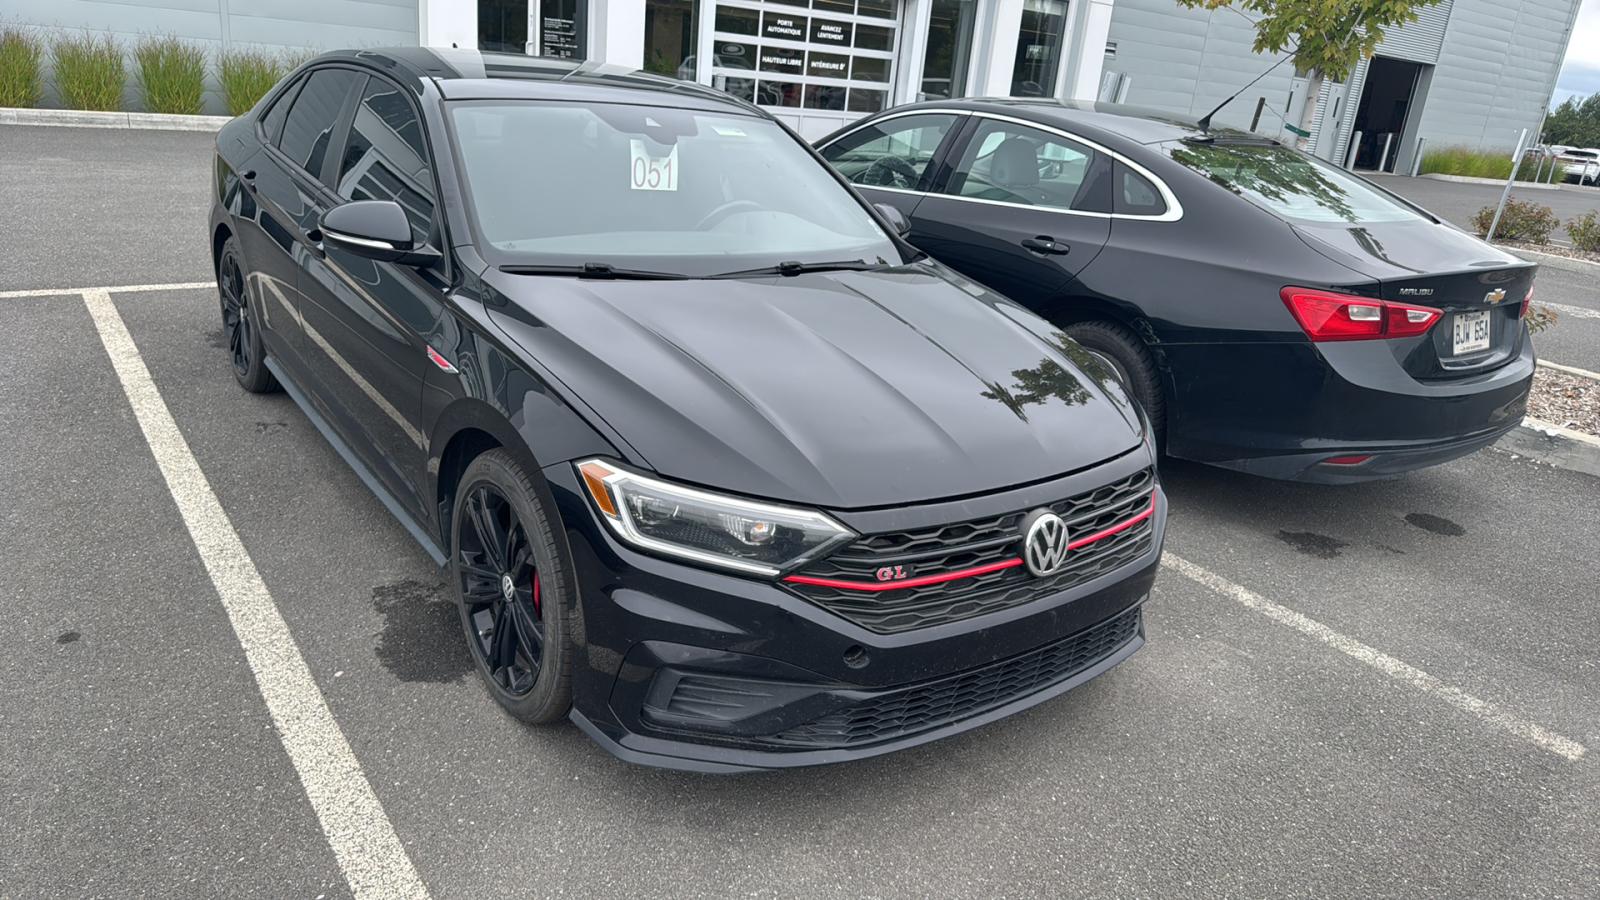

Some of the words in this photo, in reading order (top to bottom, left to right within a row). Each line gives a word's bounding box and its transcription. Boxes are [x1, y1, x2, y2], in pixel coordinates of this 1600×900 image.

[777, 19, 793, 27] PORTE
[767, 25, 802, 36] AUTOMATIQUE
[820, 24, 842, 33] AVANCEZ
[817, 31, 844, 41] LENTEMENT
[762, 56, 787, 65] HAUTEUR
[787, 58, 802, 67] LIBRE
[633, 156, 672, 189] 051
[1399, 287, 1434, 296] MALIBU
